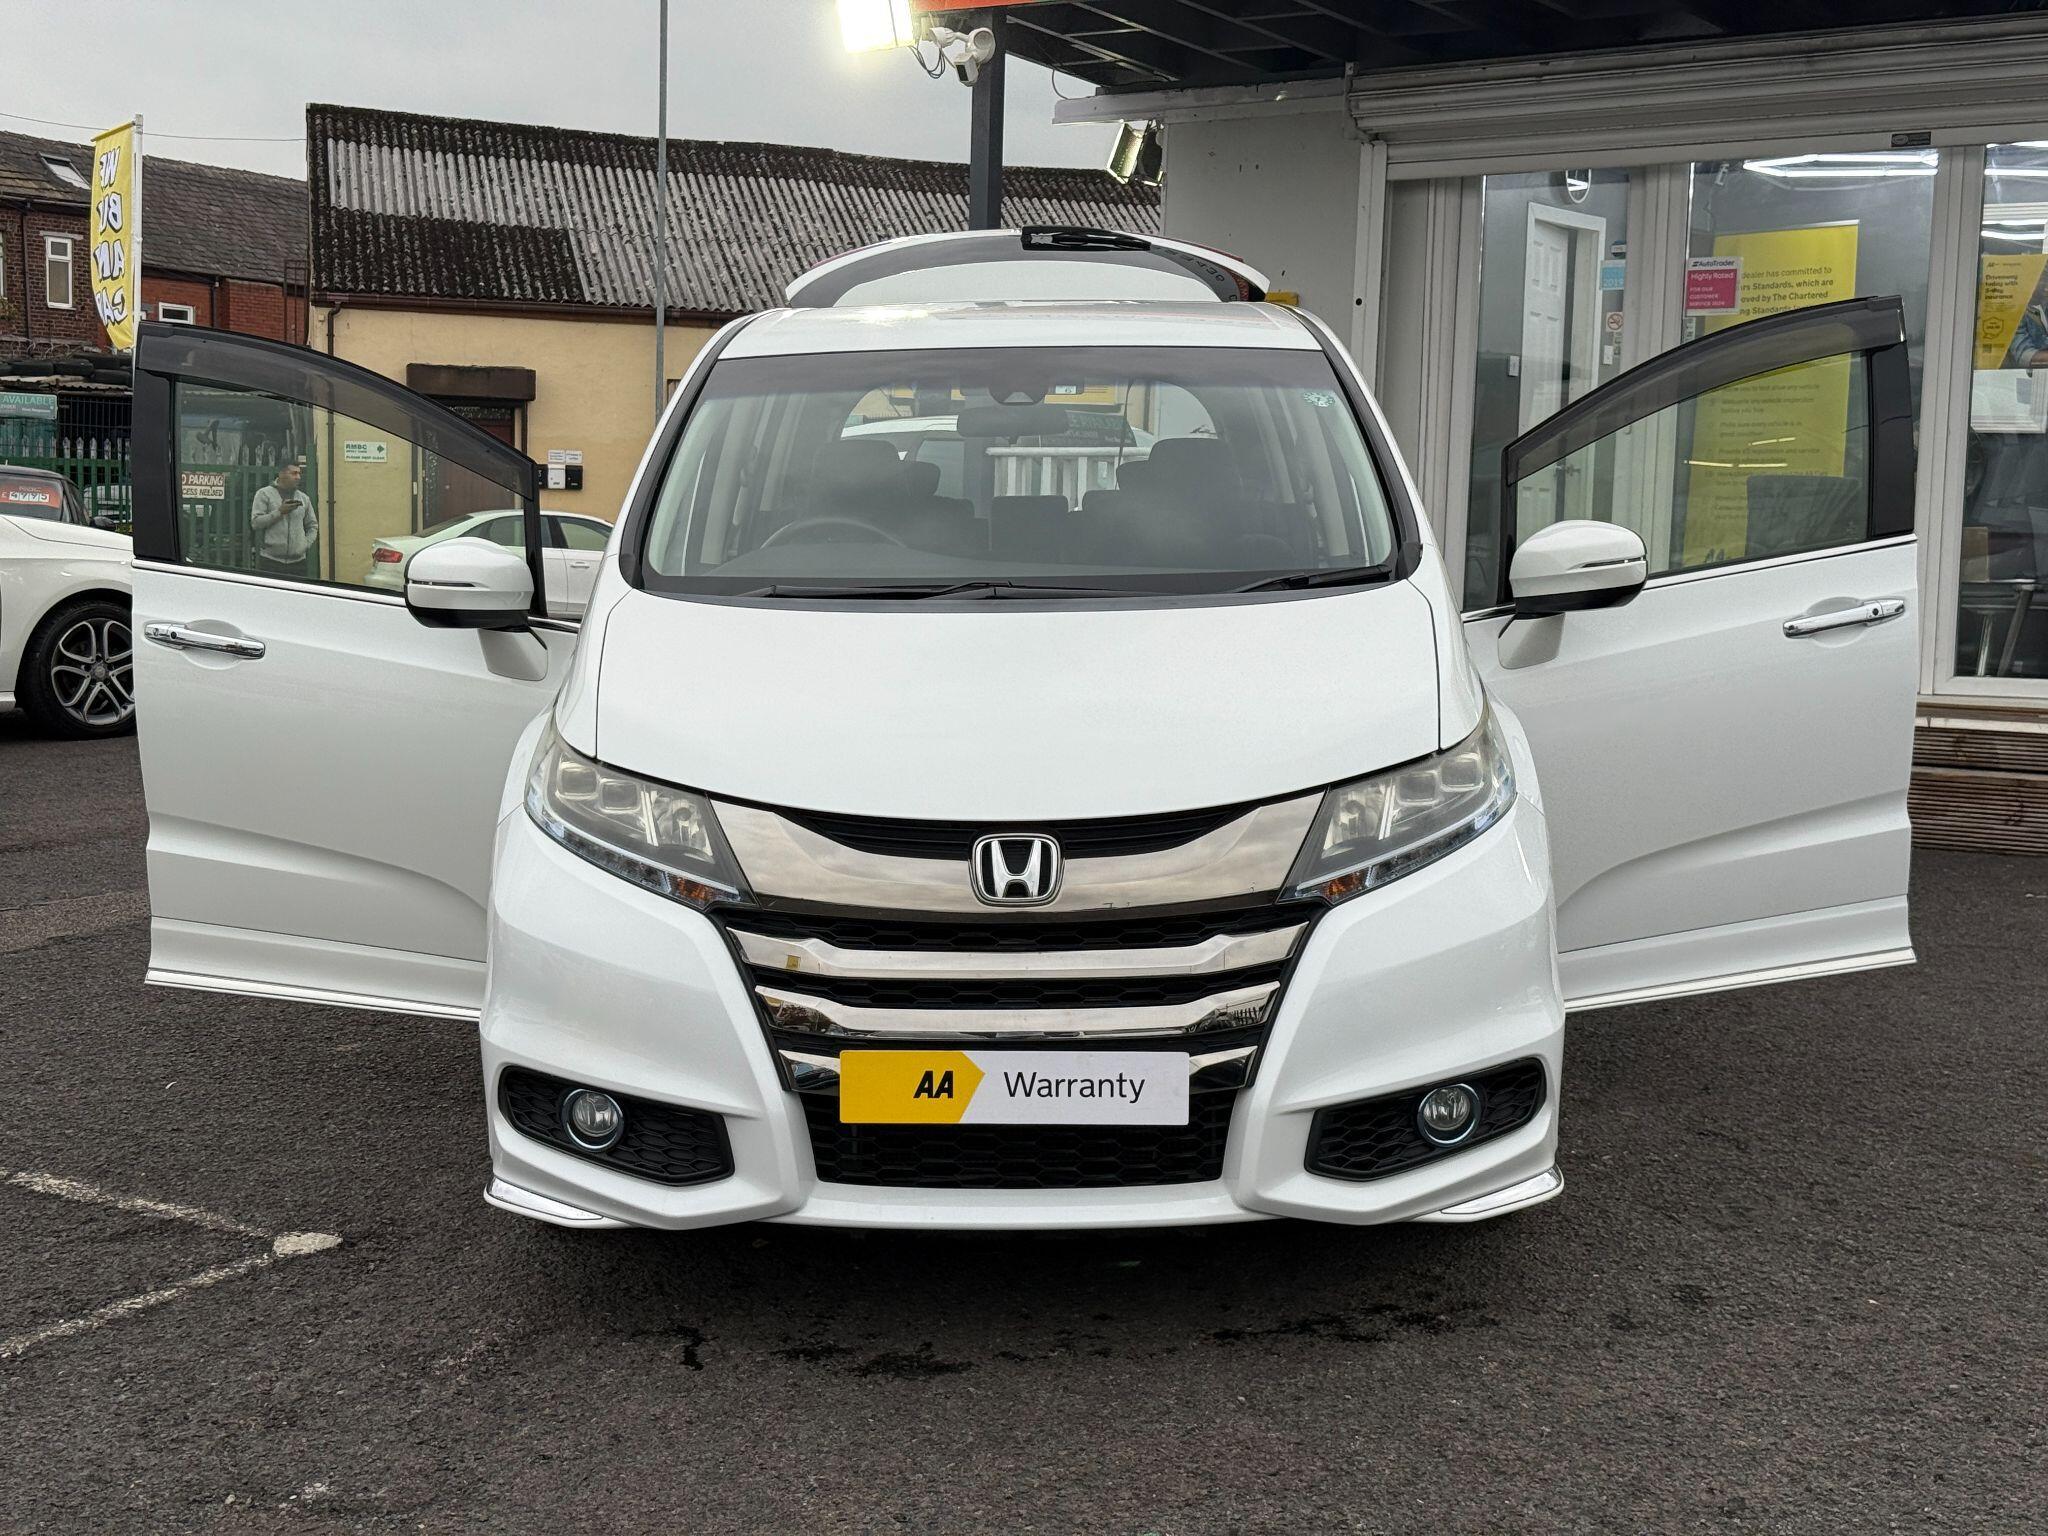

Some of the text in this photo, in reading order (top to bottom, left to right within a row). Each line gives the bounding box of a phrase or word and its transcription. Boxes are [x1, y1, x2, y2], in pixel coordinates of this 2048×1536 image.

[1690, 271, 1735, 281] Highly Rated
[1780, 266, 1822, 277] committed
[1823, 265, 1832, 274] to
[1795, 278, 1820, 287] which
[1821, 278, 1834, 286] are
[1741, 290, 1829, 303] oved by The Chartered
[2, 395, 54, 405] AVAILABLE
[189, 474, 223, 486] PARKING
[913, 1070, 1146, 1104] AA Warranty
